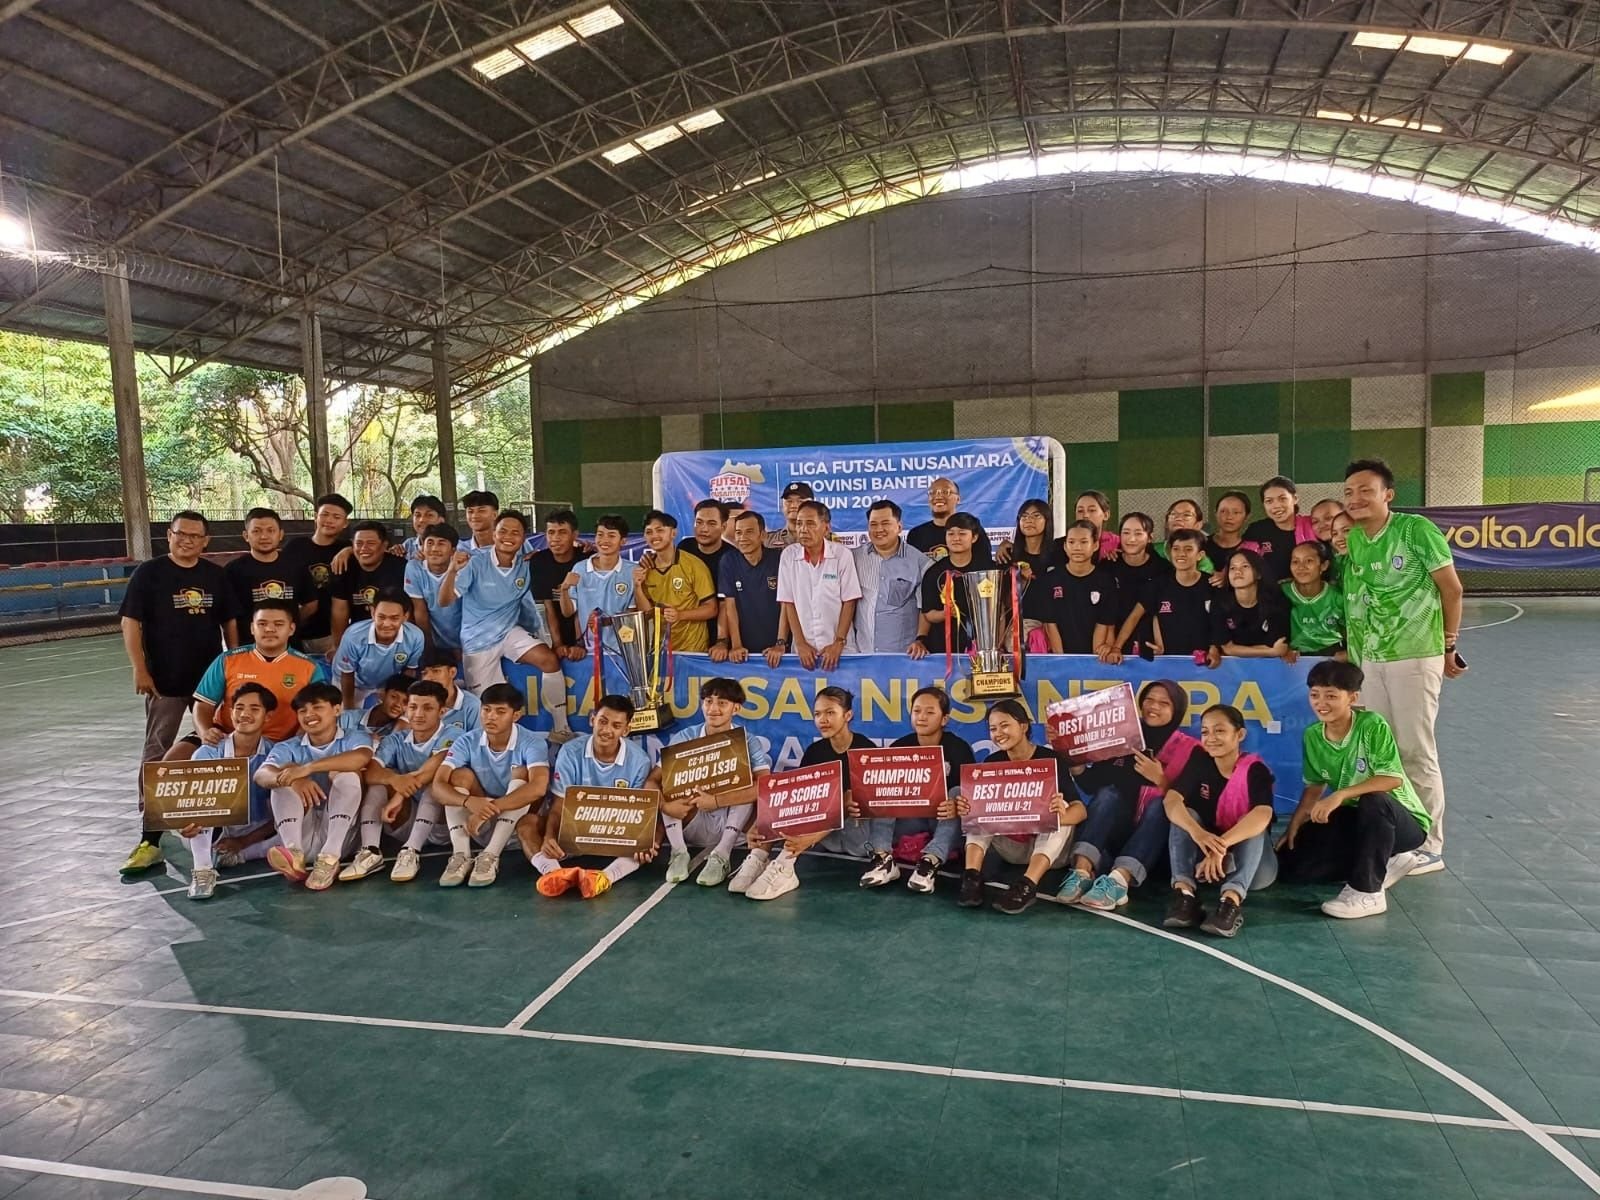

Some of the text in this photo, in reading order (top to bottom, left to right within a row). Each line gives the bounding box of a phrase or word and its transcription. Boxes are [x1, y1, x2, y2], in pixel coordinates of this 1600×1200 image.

[790, 453, 1014, 476] LIGA FUTSAL NUSANTARA
[710, 476, 750, 487] FUTSAL
[791, 477, 868, 492] OVINSI
[1059, 706, 1125, 736] BEST PLAYER
[1073, 726, 1116, 745] WOMEN U-21
[688, 751, 720, 767] MEN U-23
[674, 757, 737, 786] BEST COACH
[863, 768, 931, 784] CHAMPIONS
[155, 778, 238, 797] BEST PLAYER
[769, 791, 788, 808] TOP
[790, 782, 830, 803] SCORER
[876, 786, 921, 797] WOMEN U-21
[973, 780, 1044, 800] BEST COACH
[177, 797, 217, 808] MEN U-23
[779, 802, 820, 818] WOMEN U-21
[985, 800, 1032, 812] WOMEN U-21
[574, 806, 644, 824] CHAMPIONS
[589, 824, 626, 835] MEN U-23
